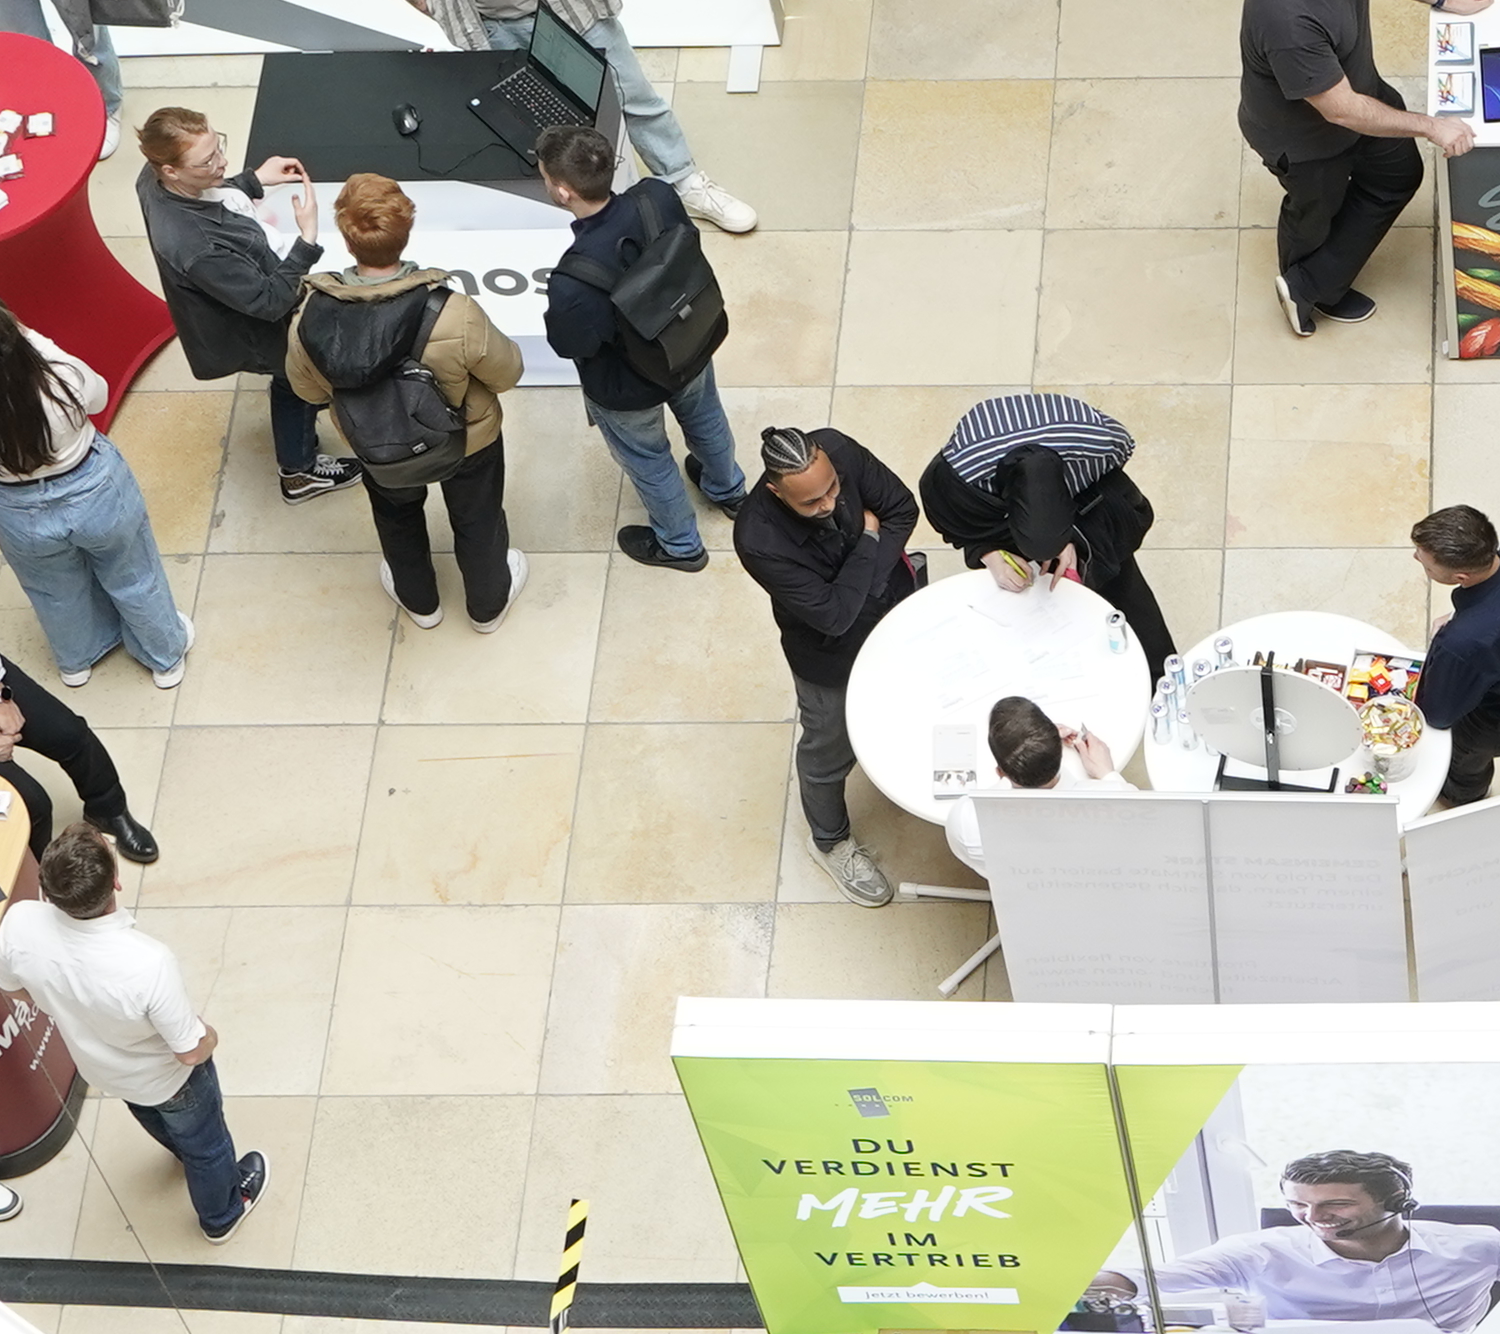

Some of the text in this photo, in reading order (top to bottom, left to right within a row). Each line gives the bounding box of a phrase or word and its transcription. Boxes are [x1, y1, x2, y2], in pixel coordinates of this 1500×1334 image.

[853, 1093, 914, 1103] SOLCOM
[852, 1138, 915, 1155] DU
[762, 1159, 1015, 1178] VERDIENST
[796, 1185, 1014, 1228] MEHR
[887, 1232, 938, 1247] IM
[814, 1252, 1021, 1268] VERTRIEB
[907, 1290, 990, 1300] bewerben!
